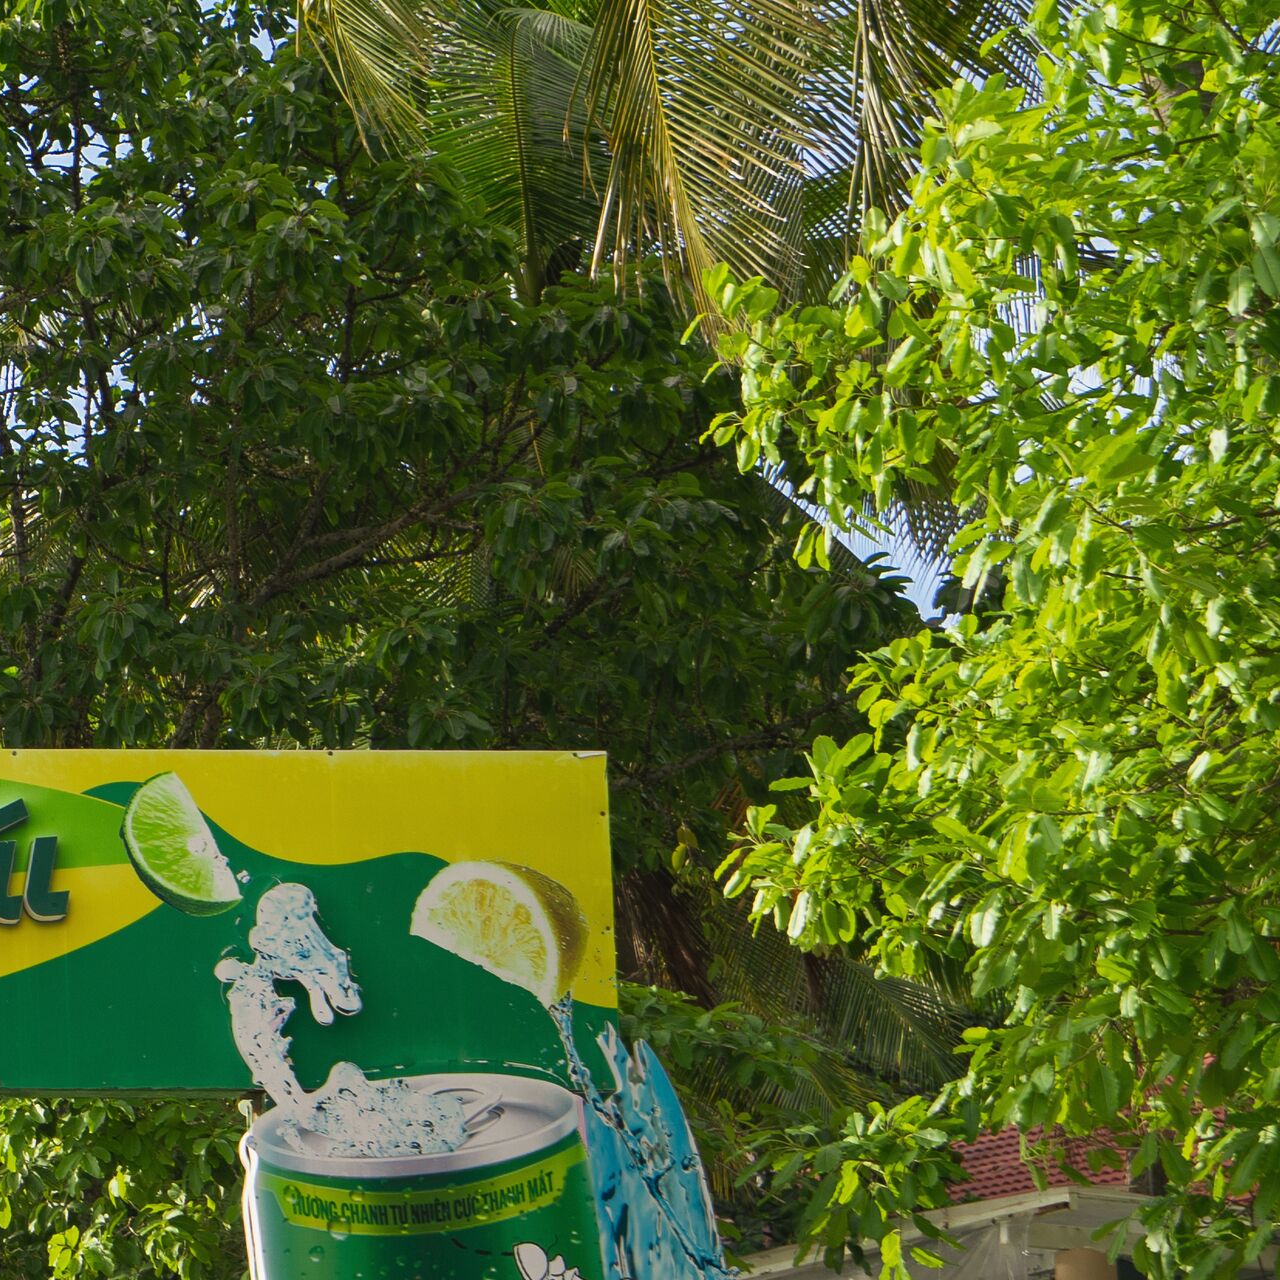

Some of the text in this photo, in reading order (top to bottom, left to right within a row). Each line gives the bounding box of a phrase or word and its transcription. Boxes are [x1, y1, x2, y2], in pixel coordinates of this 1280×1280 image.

[340, 1202, 388, 1226] CHANH
[410, 1197, 452, 1225] NHIÊN
[480, 1182, 525, 1214] THANH
[526, 1169, 553, 1203] MÁT
